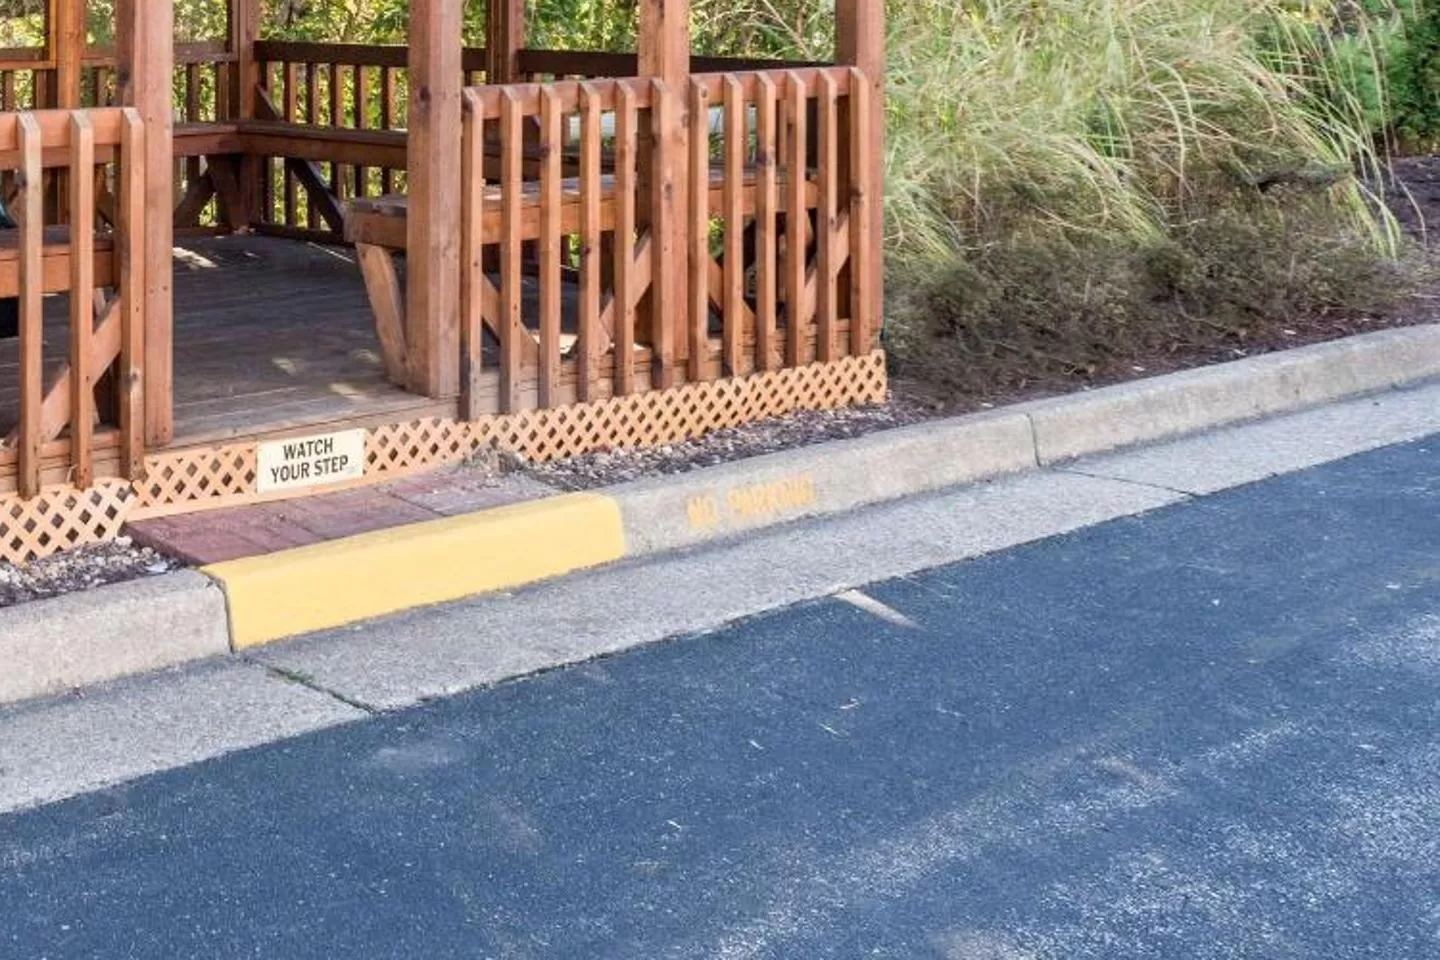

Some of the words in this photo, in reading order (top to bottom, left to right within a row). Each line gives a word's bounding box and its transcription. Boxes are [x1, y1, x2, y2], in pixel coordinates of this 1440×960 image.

[283, 437, 334, 460] WATCH
[271, 462, 310, 483] YOUR
[314, 455, 348, 476] STEP
[687, 495, 718, 529] NO
